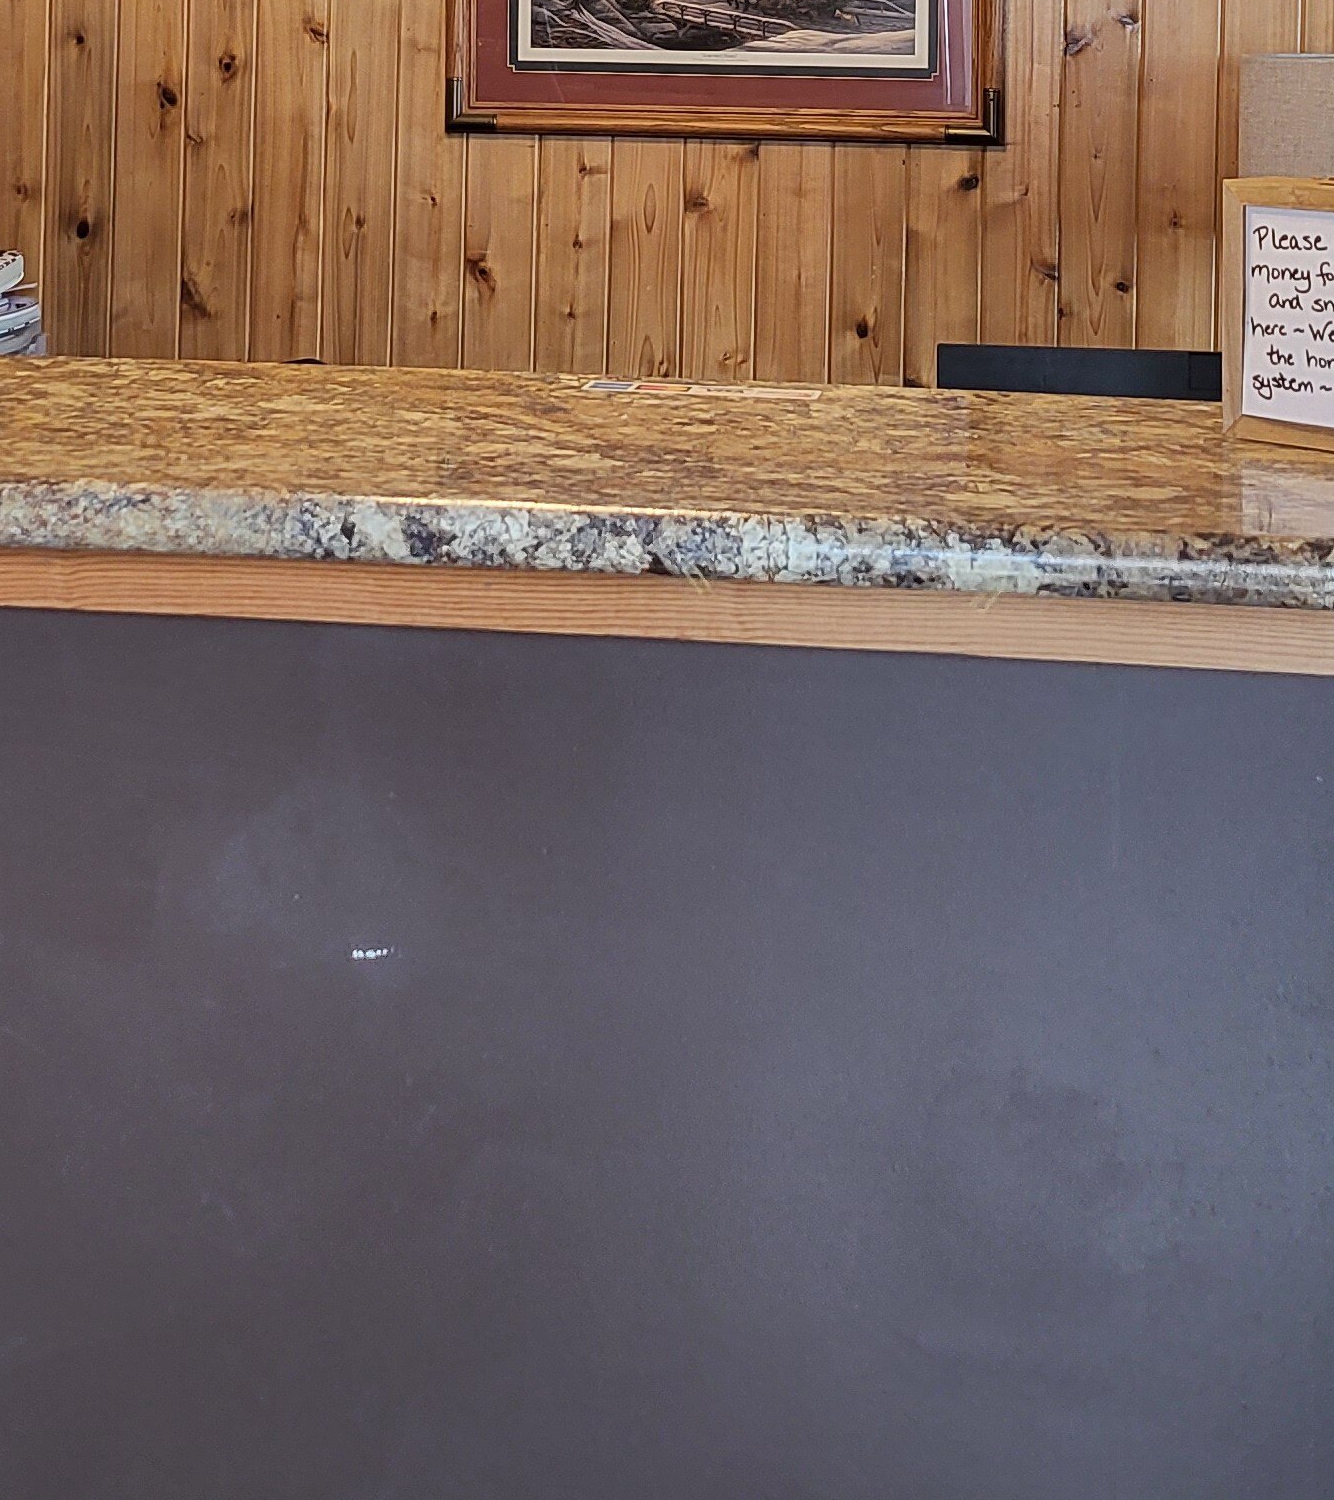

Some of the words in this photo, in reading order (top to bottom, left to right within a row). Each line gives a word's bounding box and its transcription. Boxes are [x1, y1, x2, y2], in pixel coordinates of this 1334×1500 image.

[1253, 225, 1328, 251] Please
[1251, 264, 1312, 294] money
[1268, 293, 1304, 311] and
[1250, 316, 1288, 337] here
[1266, 344, 1295, 366] the
[1252, 372, 1314, 401] system
